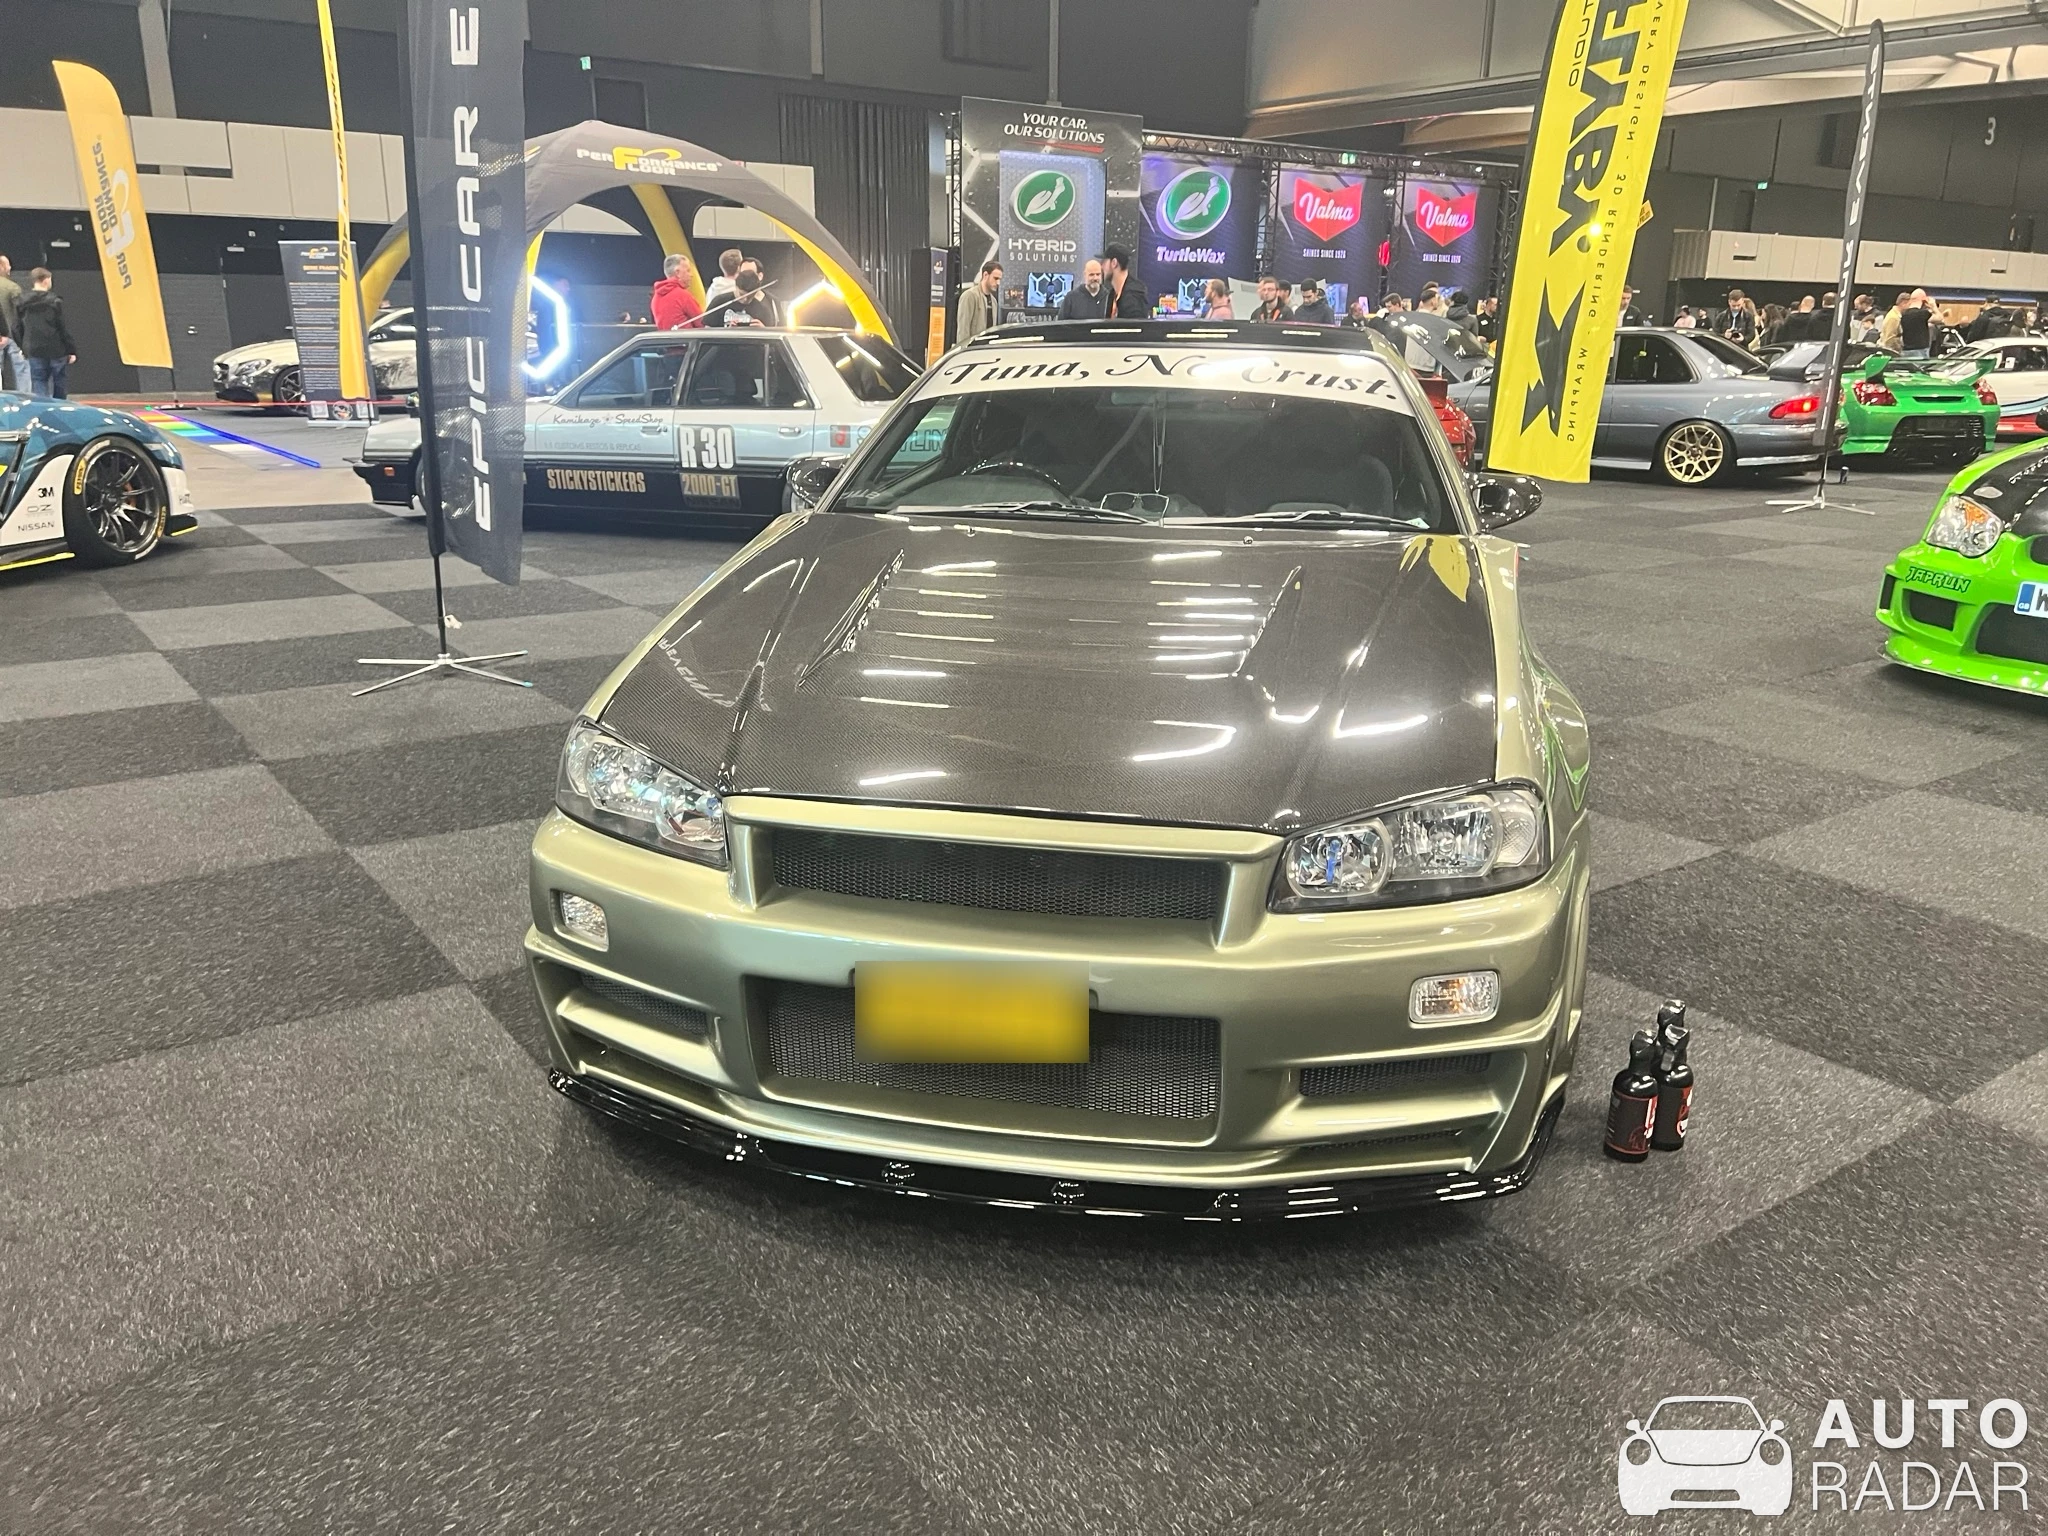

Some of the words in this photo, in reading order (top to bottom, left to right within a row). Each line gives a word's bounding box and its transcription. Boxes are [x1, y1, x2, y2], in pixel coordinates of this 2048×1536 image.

[1023, 112, 1058, 126] YOUR
[1060, 116, 1088, 129] CAR.
[1985, 116, 1997, 145] 3
[1003, 123, 1033, 136] OUR
[1033, 126, 1105, 144] SOLUTIONS
[453, 105, 481, 303] CAR
[1299, 191, 1354, 222] Valma
[1420, 200, 1470, 229] Valma
[1008, 237, 1077, 253] HYBRID
[1009, 251, 1076, 263] SOLUTIONS
[944, 357, 1090, 385] Tuna,
[1241, 358, 1398, 400] Crust.
[553, 413, 601, 428] Kamikaze
[466, 336, 492, 532] EPIC
[37, 486, 55, 498] 3M
[546, 468, 646, 493] STICKYSTICKERS
[682, 473, 737, 497] 2000-GT
[18, 521, 54, 531] NISSAN
[1906, 566, 1972, 594] JAPRUN
